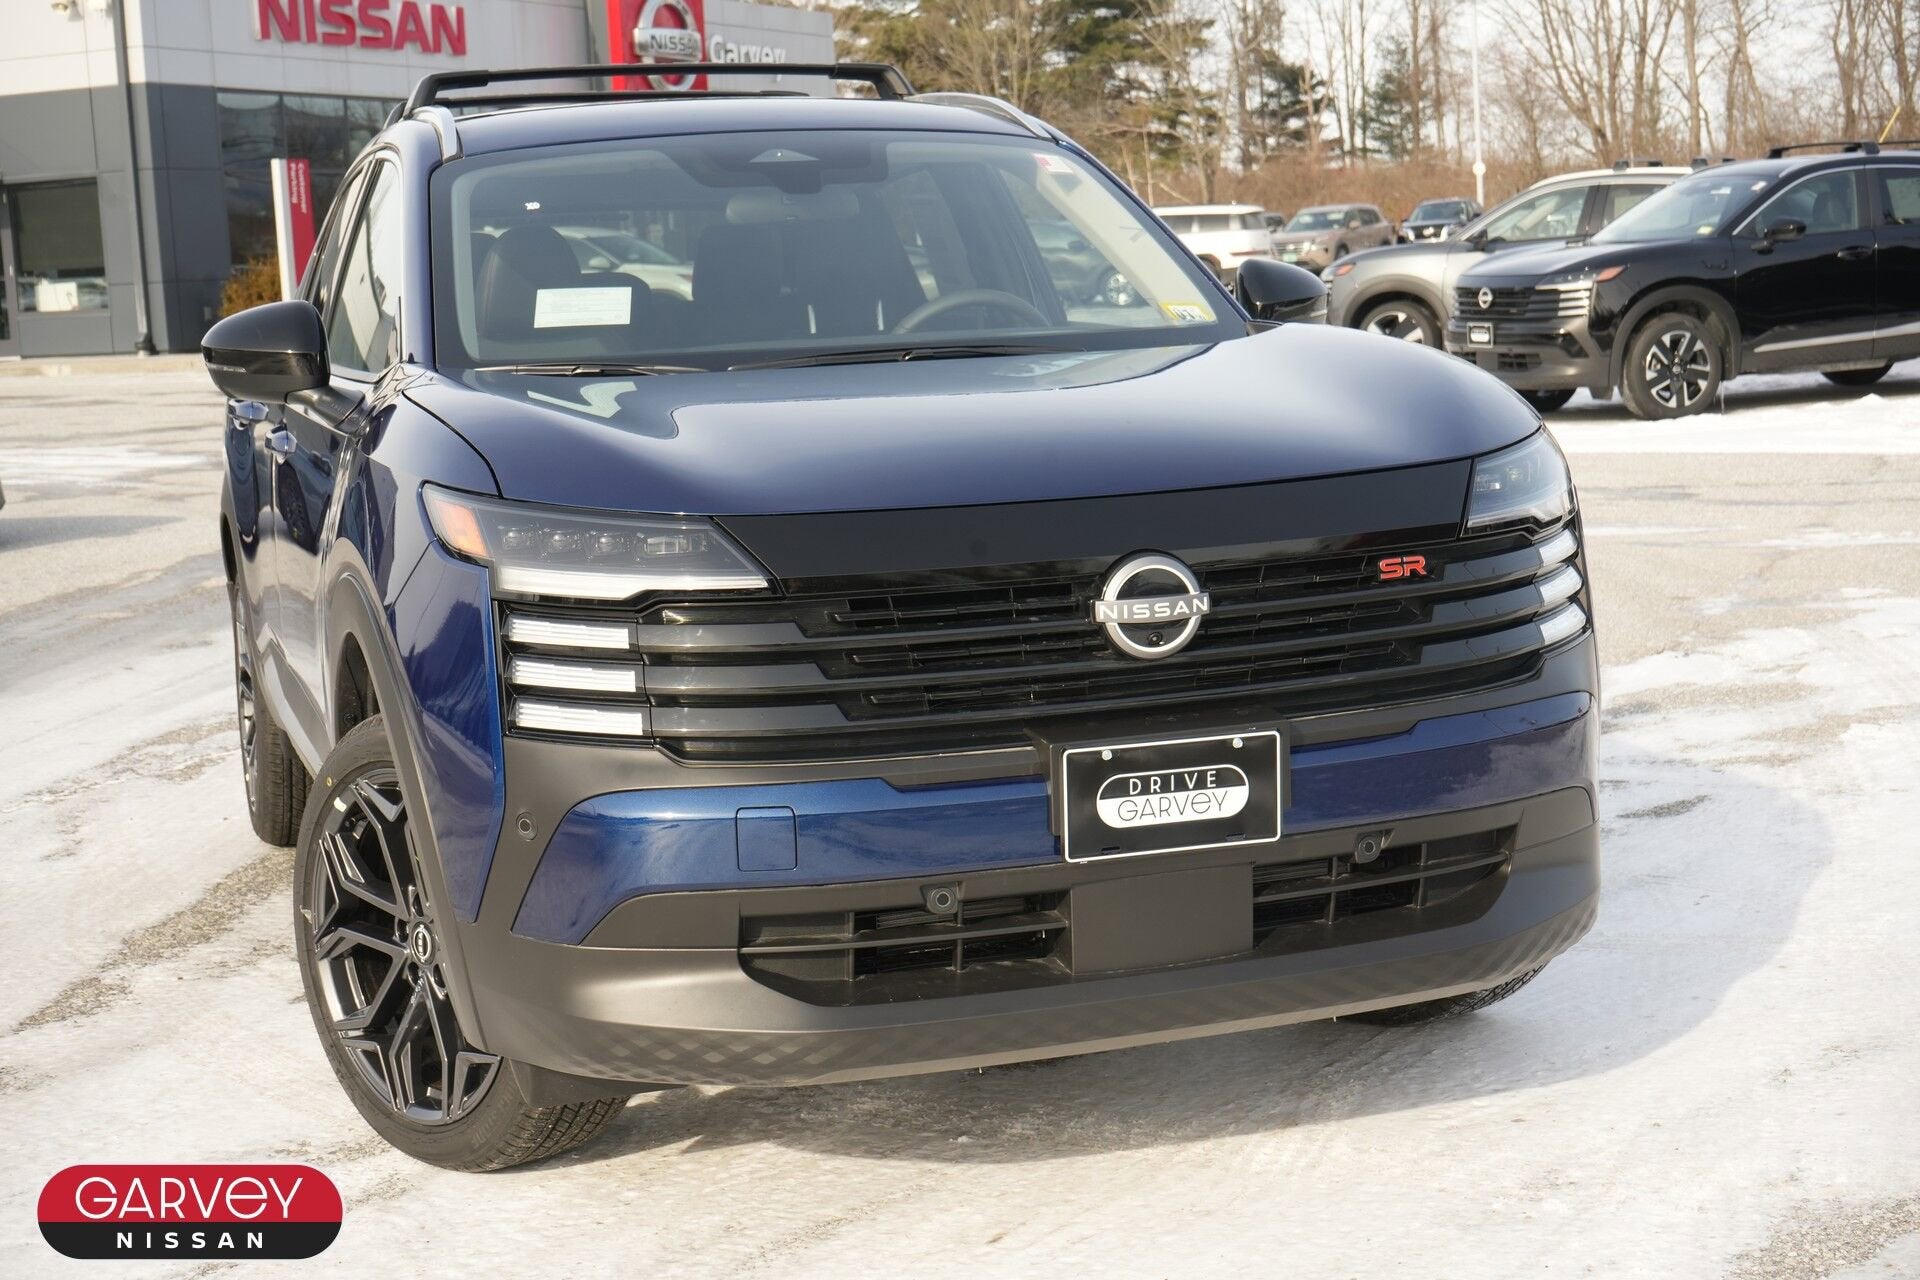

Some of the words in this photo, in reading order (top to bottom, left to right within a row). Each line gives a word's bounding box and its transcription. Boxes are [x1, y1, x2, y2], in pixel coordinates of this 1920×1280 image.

[257, 0, 467, 56] NISSAN
[709, 34, 786, 82] Garvey
[1379, 556, 1427, 579] SR
[1100, 596, 1208, 620] NISSAN
[1129, 770, 1217, 796] DRIVE
